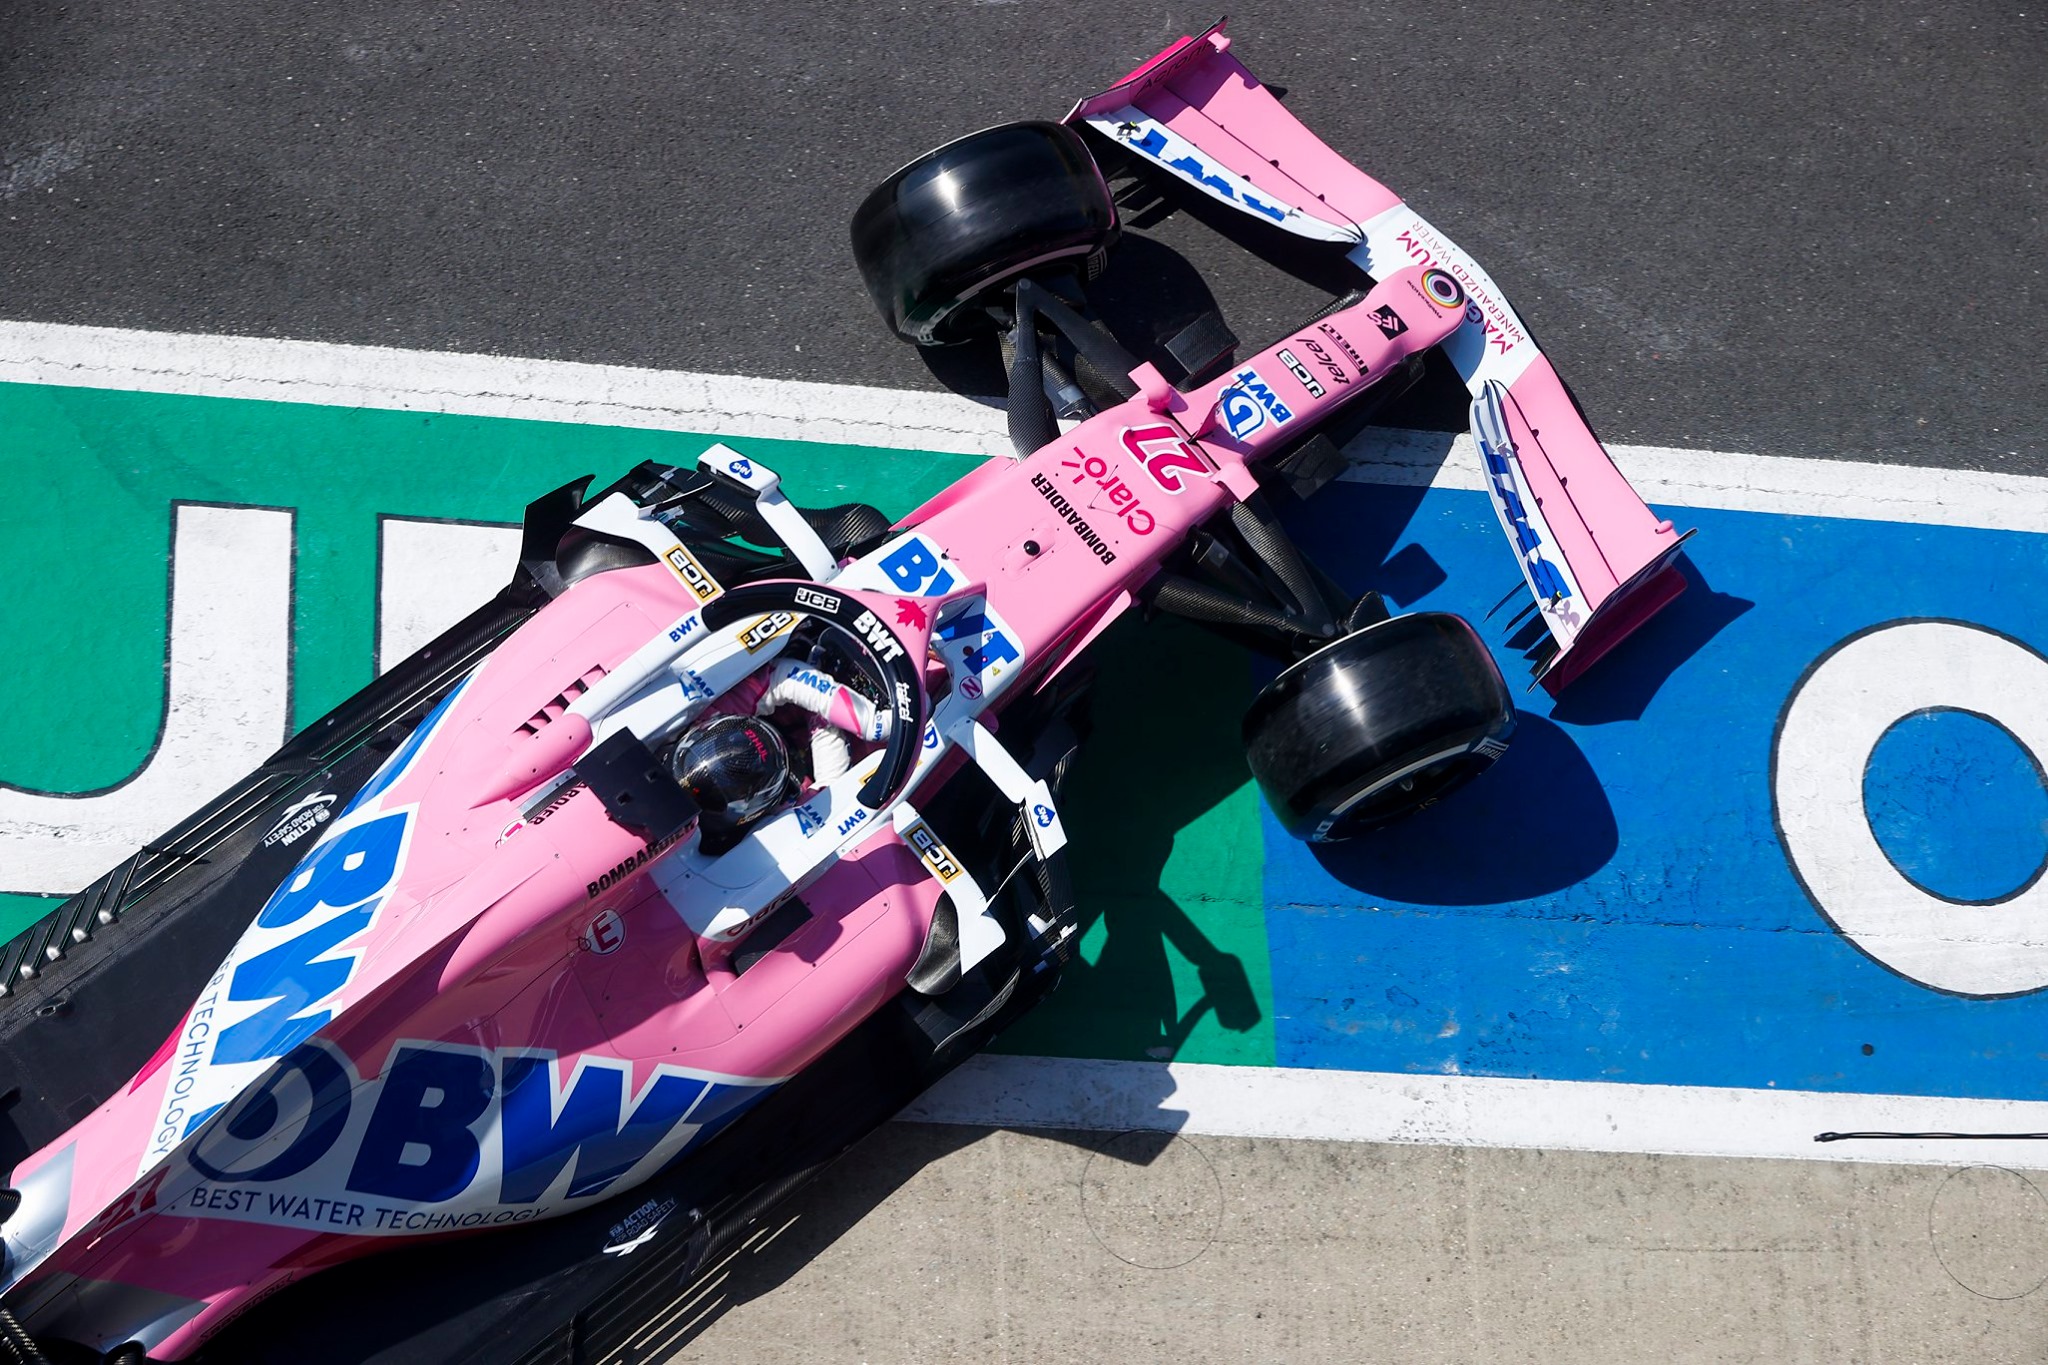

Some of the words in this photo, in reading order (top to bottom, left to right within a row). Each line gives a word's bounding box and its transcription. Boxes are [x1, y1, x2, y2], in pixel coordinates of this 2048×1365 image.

[1412, 221, 1452, 264] WATER
[1367, 312, 1399, 332] IFS
[1452, 264, 1525, 343] MINERALIZED
[1296, 338, 1350, 385] telcel
[1318, 323, 1369, 377] PIRELLI
[1277, 348, 1326, 399] JCB
[1237, 371, 1292, 423] BWT
[1119, 423, 1214, 495] 27
[1084, 457, 1155, 535] Claro
[1030, 472, 1117, 566] BOMBARDIER
[669, 550, 714, 598] JCB
[795, 588, 841, 613] JCB
[668, 615, 699, 643] BWT
[853, 610, 904, 663] BWT
[688, 670, 715, 697] BWT
[787, 666, 831, 694] BWT
[895, 682, 914, 722] telcel
[291, 809, 313, 828] ROAD
[530, 781, 588, 826] ARDIER
[837, 808, 867, 836] BWT
[263, 823, 293, 848] SAFETY
[281, 817, 317, 847] ACTION
[911, 830, 957, 879] JCB
[153, 992, 218, 1154] TECHNOLOGY
[191, 1187, 260, 1213] BEST
[267, 1192, 363, 1228] WATER
[375, 1205, 550, 1230] TECHNOLOGY
[624, 1199, 658, 1228] ACTION
[626, 1219, 649, 1237] ROAD
[647, 1197, 676, 1222] SAFETY
